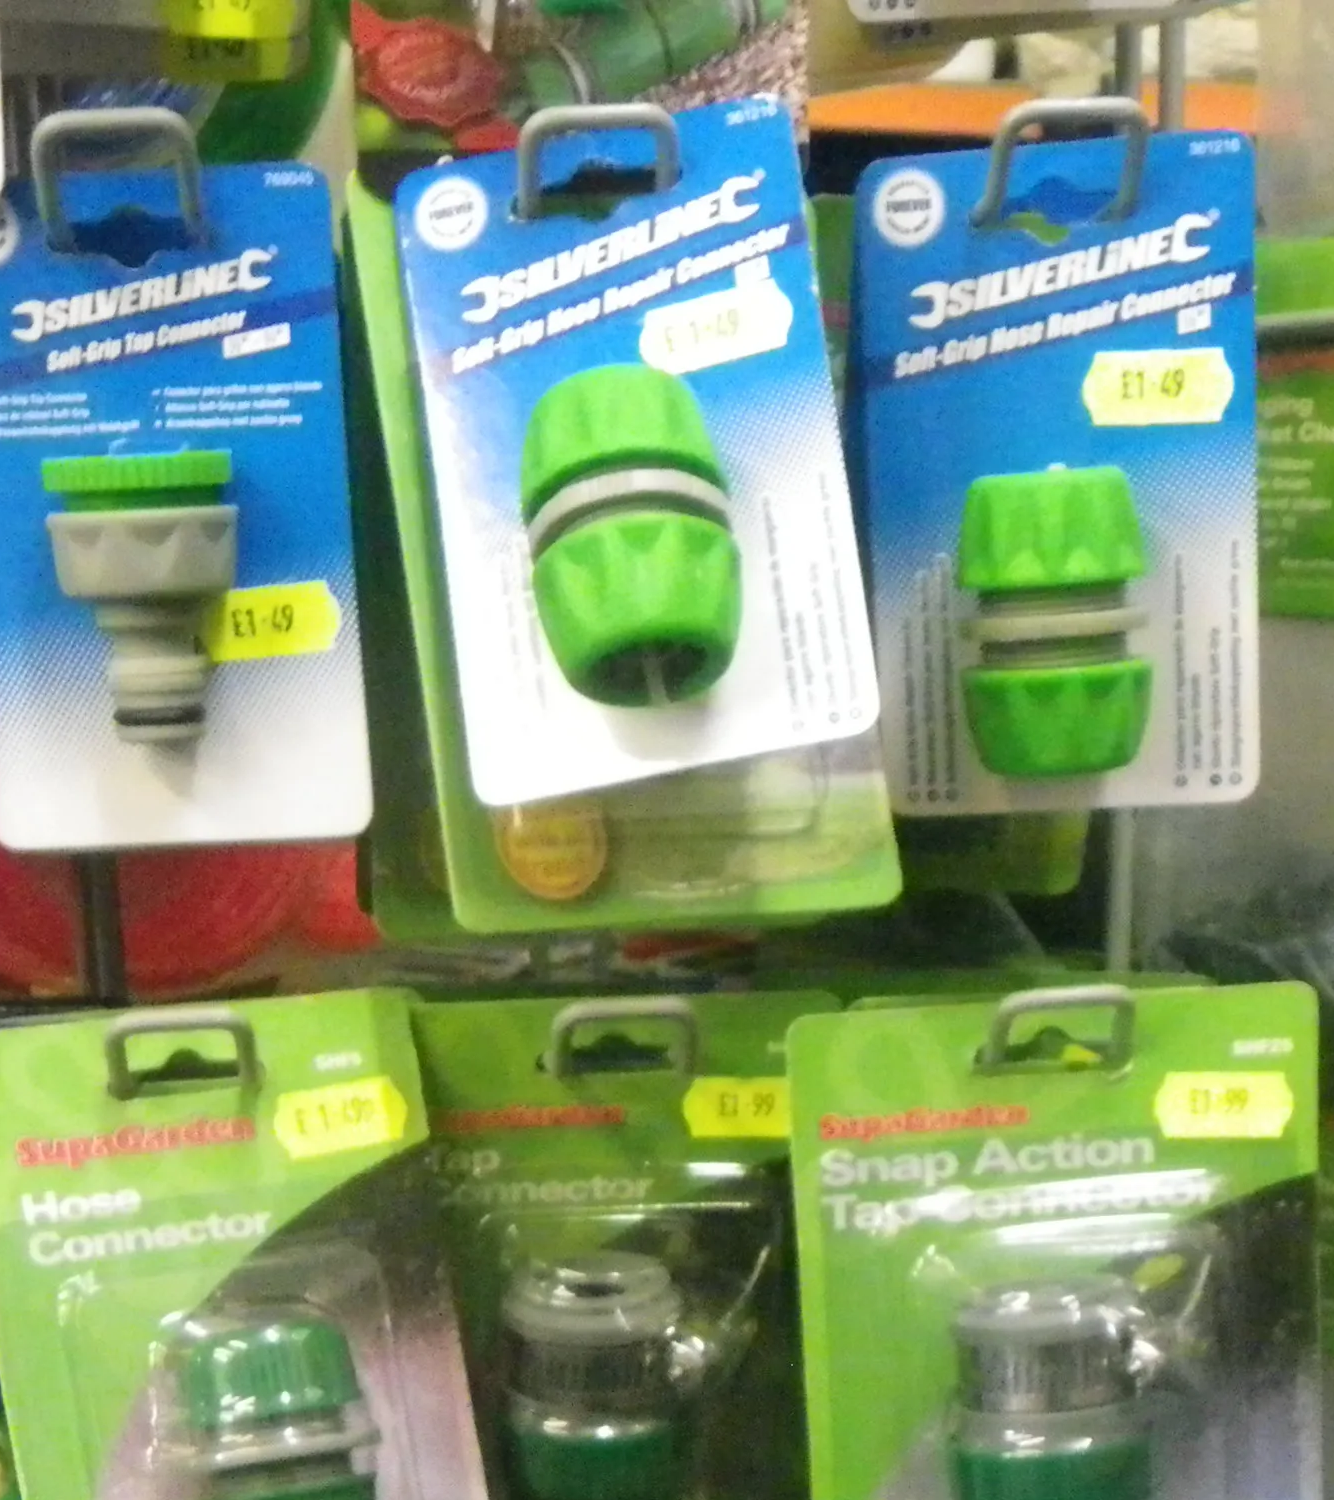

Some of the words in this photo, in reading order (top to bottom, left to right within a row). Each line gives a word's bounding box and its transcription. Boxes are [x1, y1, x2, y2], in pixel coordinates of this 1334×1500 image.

[494, 186, 723, 311] SILVERLINE
[946, 225, 1175, 317] SILVERLINE
[42, 264, 243, 333] SILVERLINE
[451, 317, 546, 375] Soft-Grip
[547, 296, 601, 335] Hose
[603, 267, 675, 323] Repair
[674, 223, 791, 286] Connector
[893, 335, 989, 380] Soft-Grip
[990, 319, 1045, 354] Hose
[1047, 300, 1120, 341] Repair
[1120, 272, 1238, 322] Connector
[46, 336, 121, 374] Soft-Grip
[124, 328, 154, 353] Tap
[156, 310, 247, 347] Connector
[16, 1116, 256, 1170] SupaGarden
[819, 1147, 958, 1187] Snap
[972, 1135, 1157, 1176] Action
[21, 1186, 143, 1226] Hose
[822, 1194, 917, 1236] Tap
[28, 1210, 272, 1267] Connector
